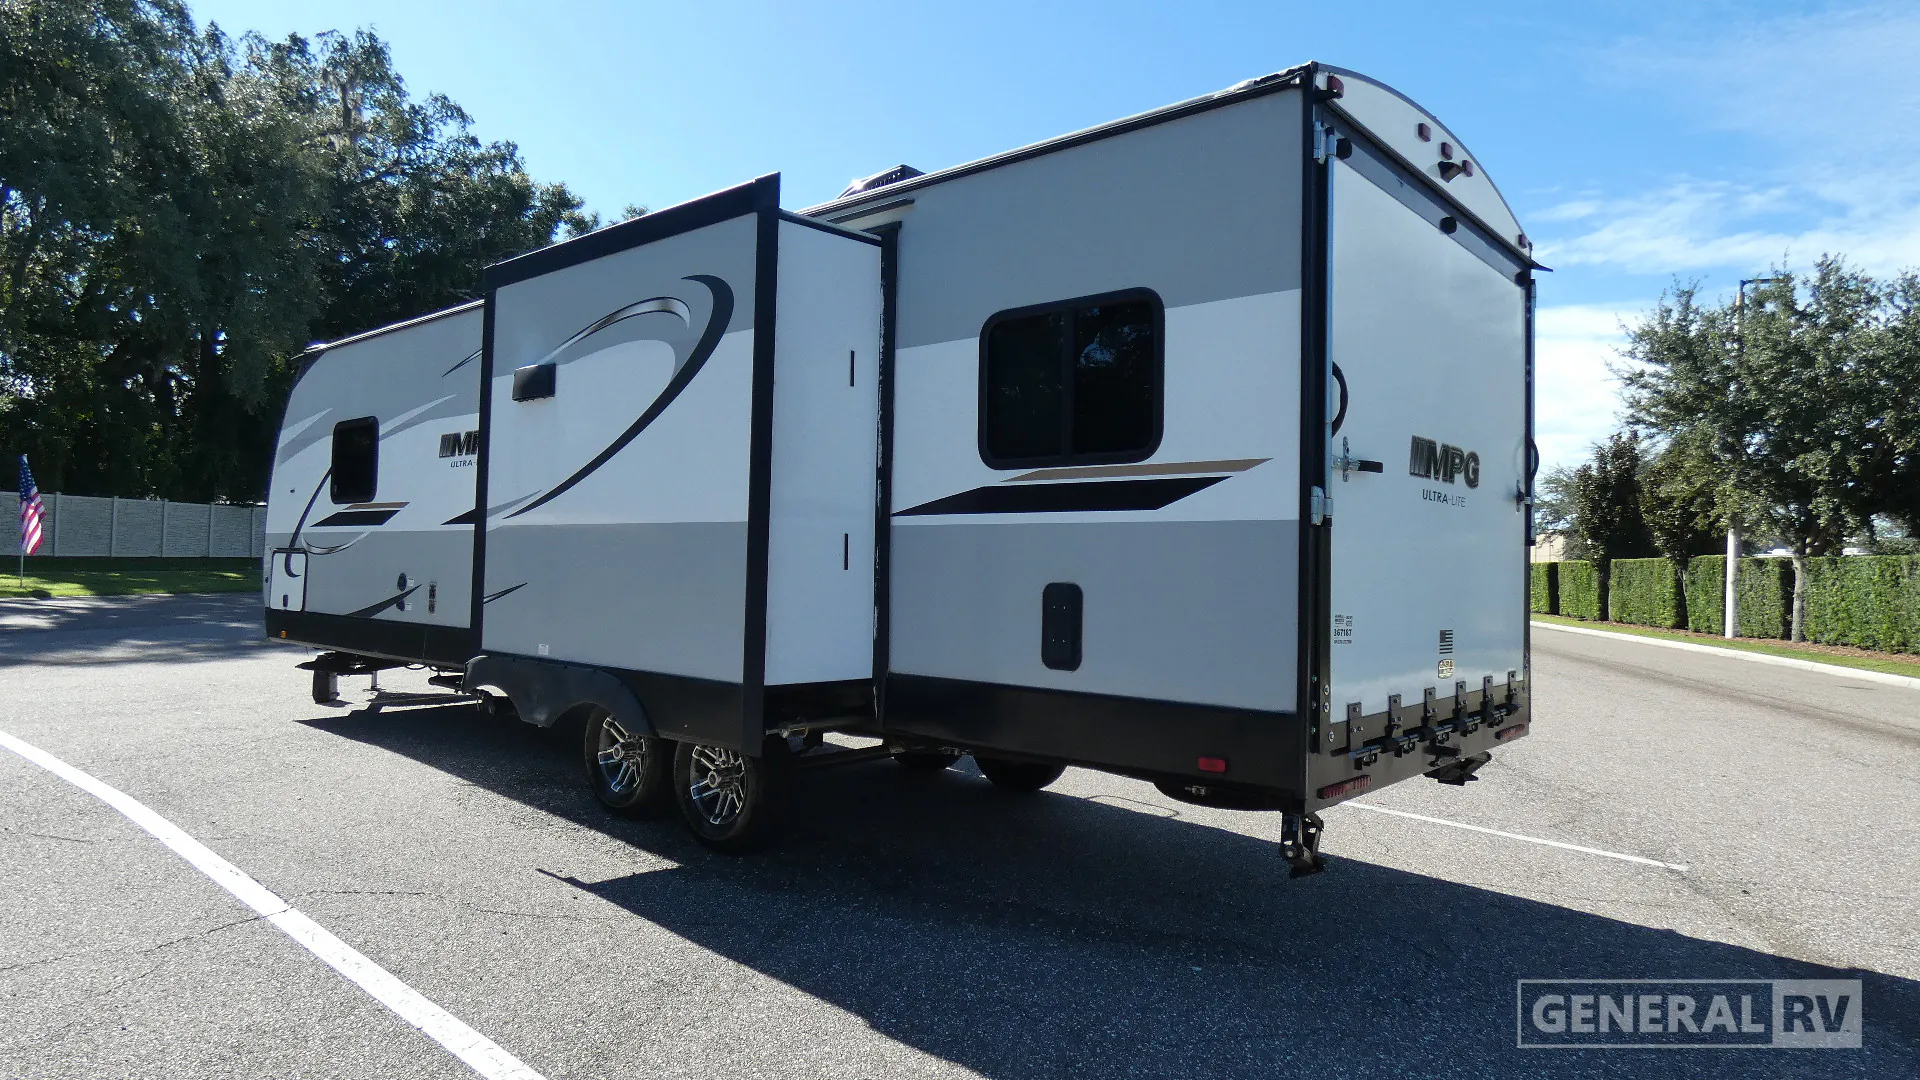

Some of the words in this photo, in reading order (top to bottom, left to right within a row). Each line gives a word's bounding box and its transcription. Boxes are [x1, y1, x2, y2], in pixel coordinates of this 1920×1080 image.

[450, 459, 477, 468] ULTRA-
[1409, 434, 1480, 489] MPG
[1422, 488, 1466, 508] ULTRA-LITE
